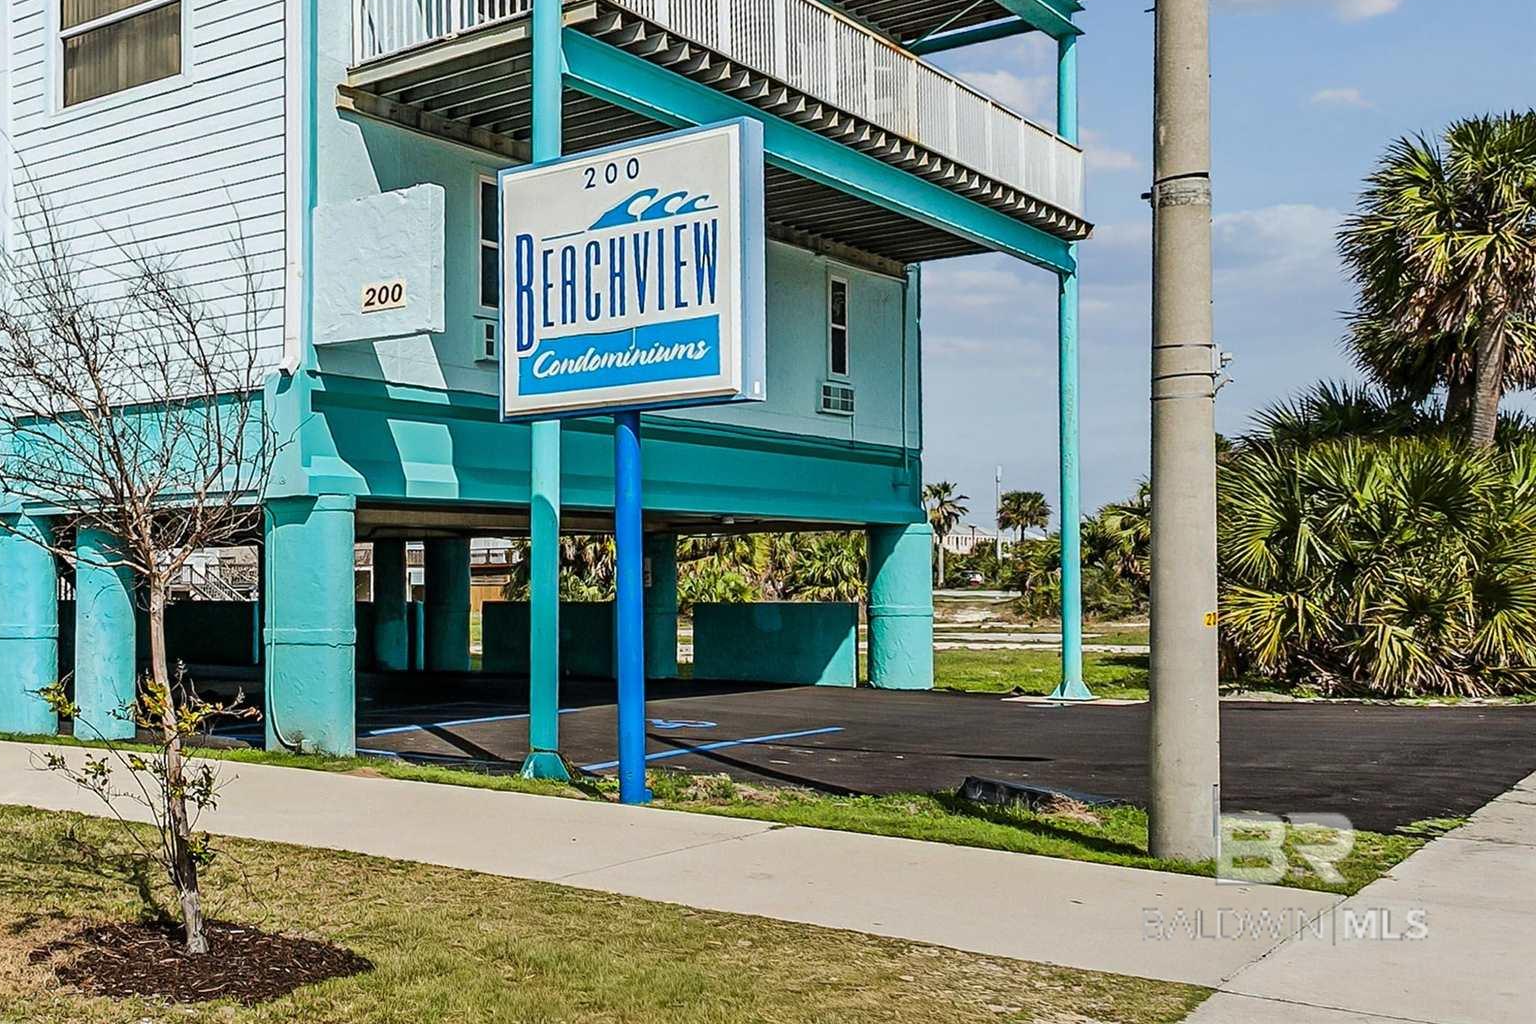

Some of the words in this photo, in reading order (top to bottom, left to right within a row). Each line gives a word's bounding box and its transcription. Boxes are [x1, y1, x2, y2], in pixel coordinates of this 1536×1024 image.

[583, 157, 640, 190] 200
[364, 283, 403, 307] 200
[515, 218, 718, 353] BEACHVIEW
[532, 339, 711, 380] Condominiums
